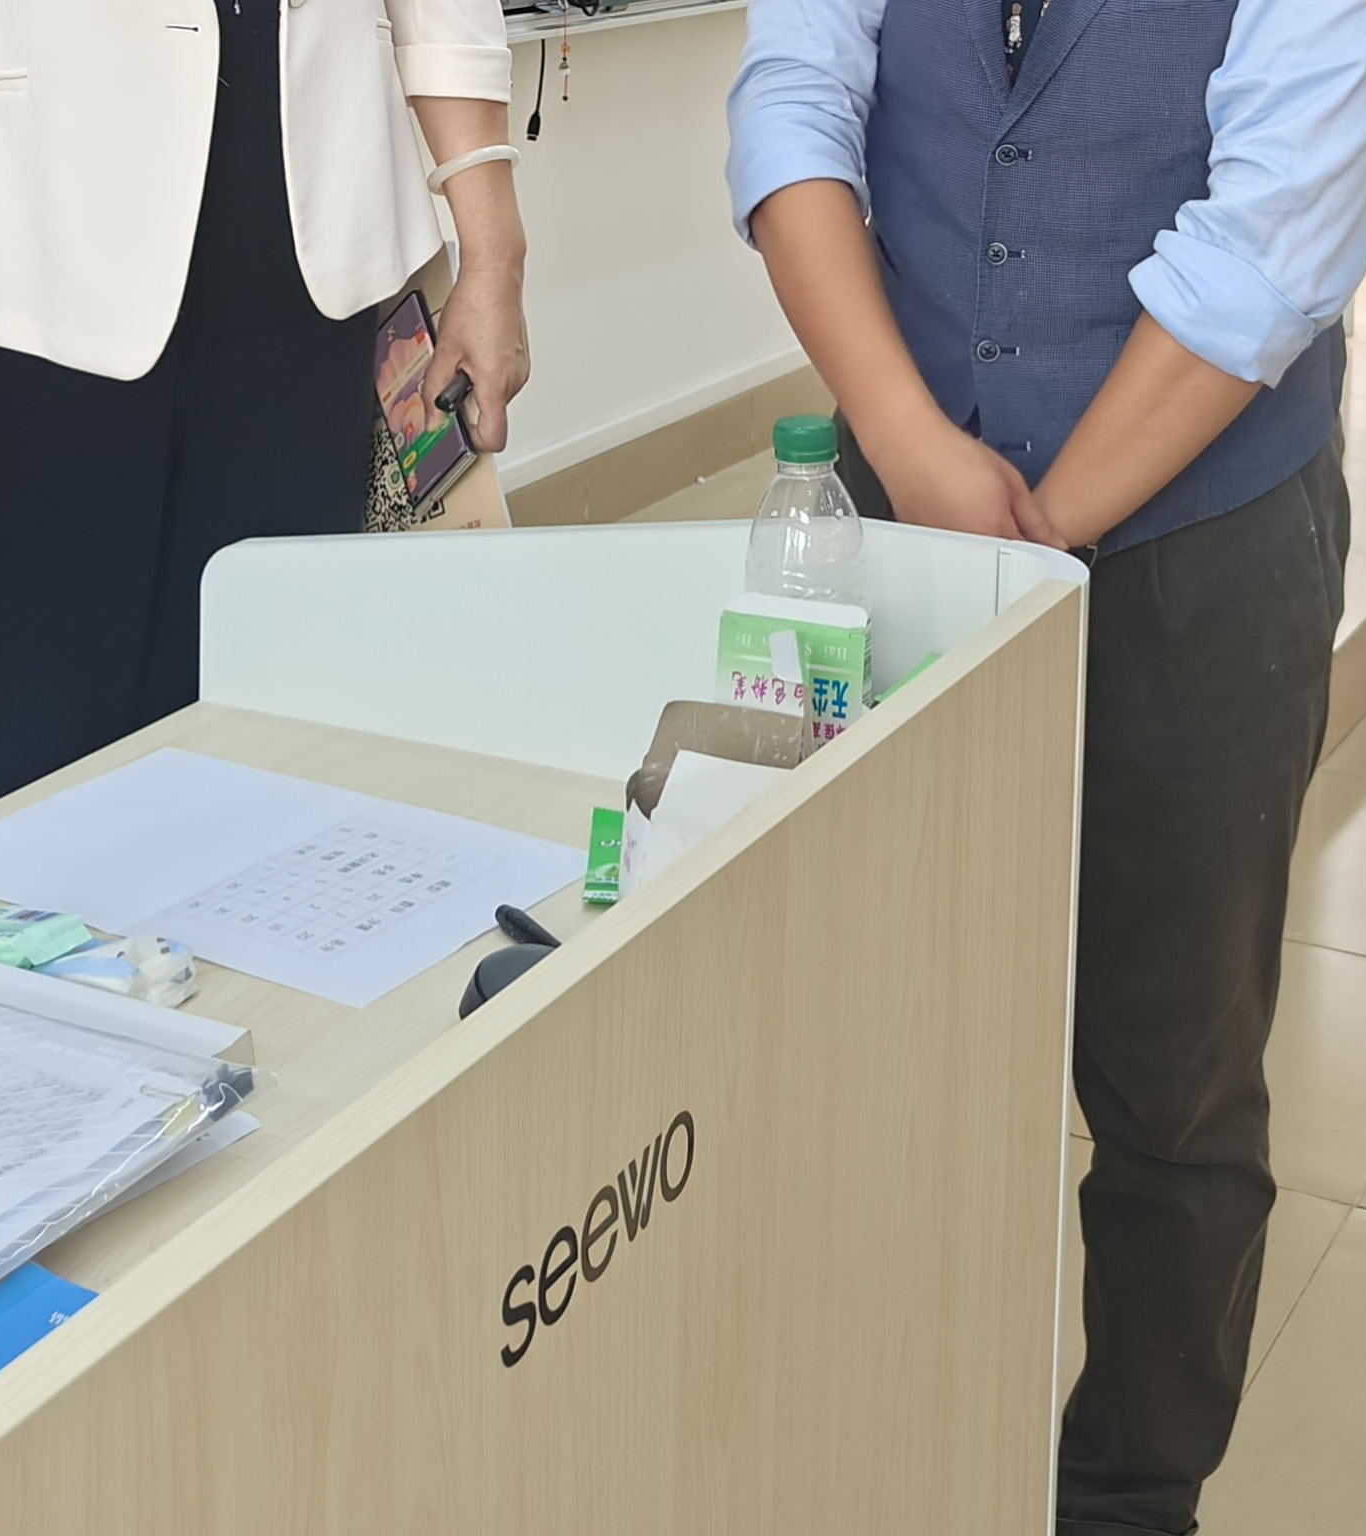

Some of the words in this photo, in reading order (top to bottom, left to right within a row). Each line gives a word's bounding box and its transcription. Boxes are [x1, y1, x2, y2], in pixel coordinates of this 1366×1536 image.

[824, 645, 847, 661] Bai
[732, 671, 805, 707] 白色粉笔
[812, 678, 849, 720] 无尘
[500, 1110, 695, 1368] seewo
